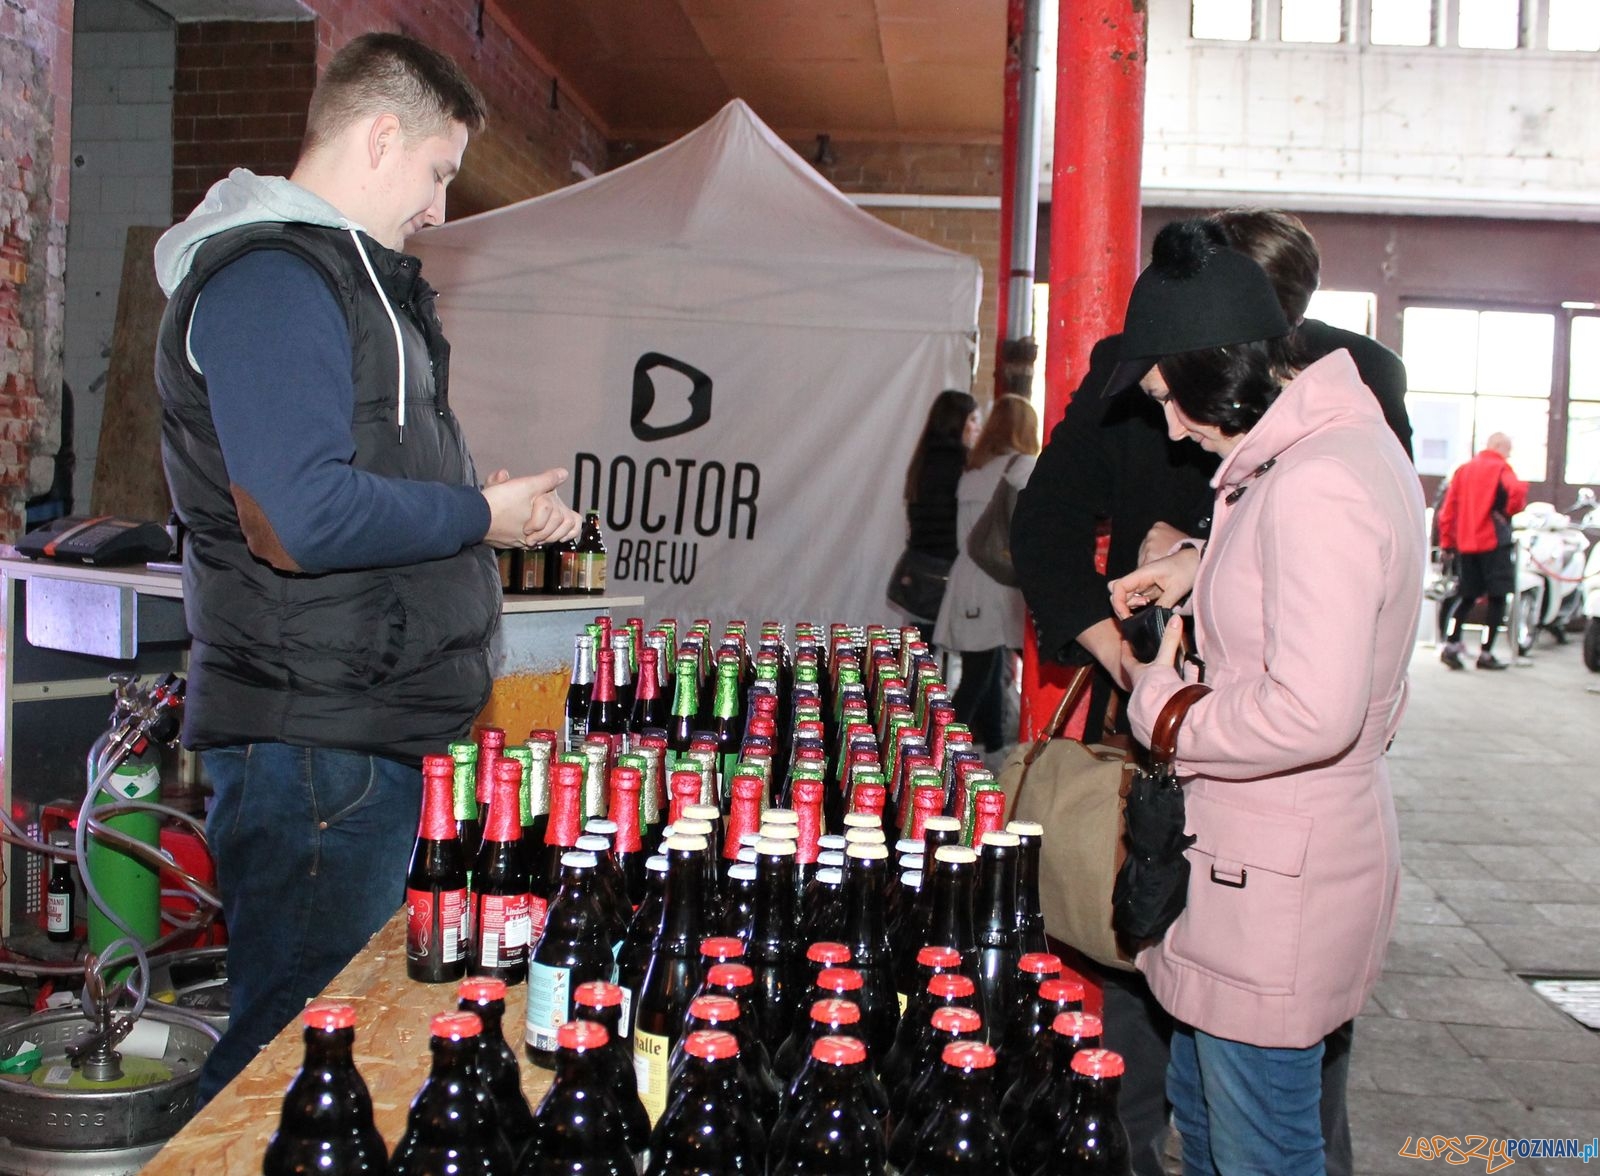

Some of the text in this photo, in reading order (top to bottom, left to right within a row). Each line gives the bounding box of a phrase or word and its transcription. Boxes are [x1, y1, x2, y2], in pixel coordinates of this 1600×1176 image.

[572, 452, 760, 540] DOCTOR
[613, 538, 698, 585] BREW
[47, 1112, 105, 1127] 2003
